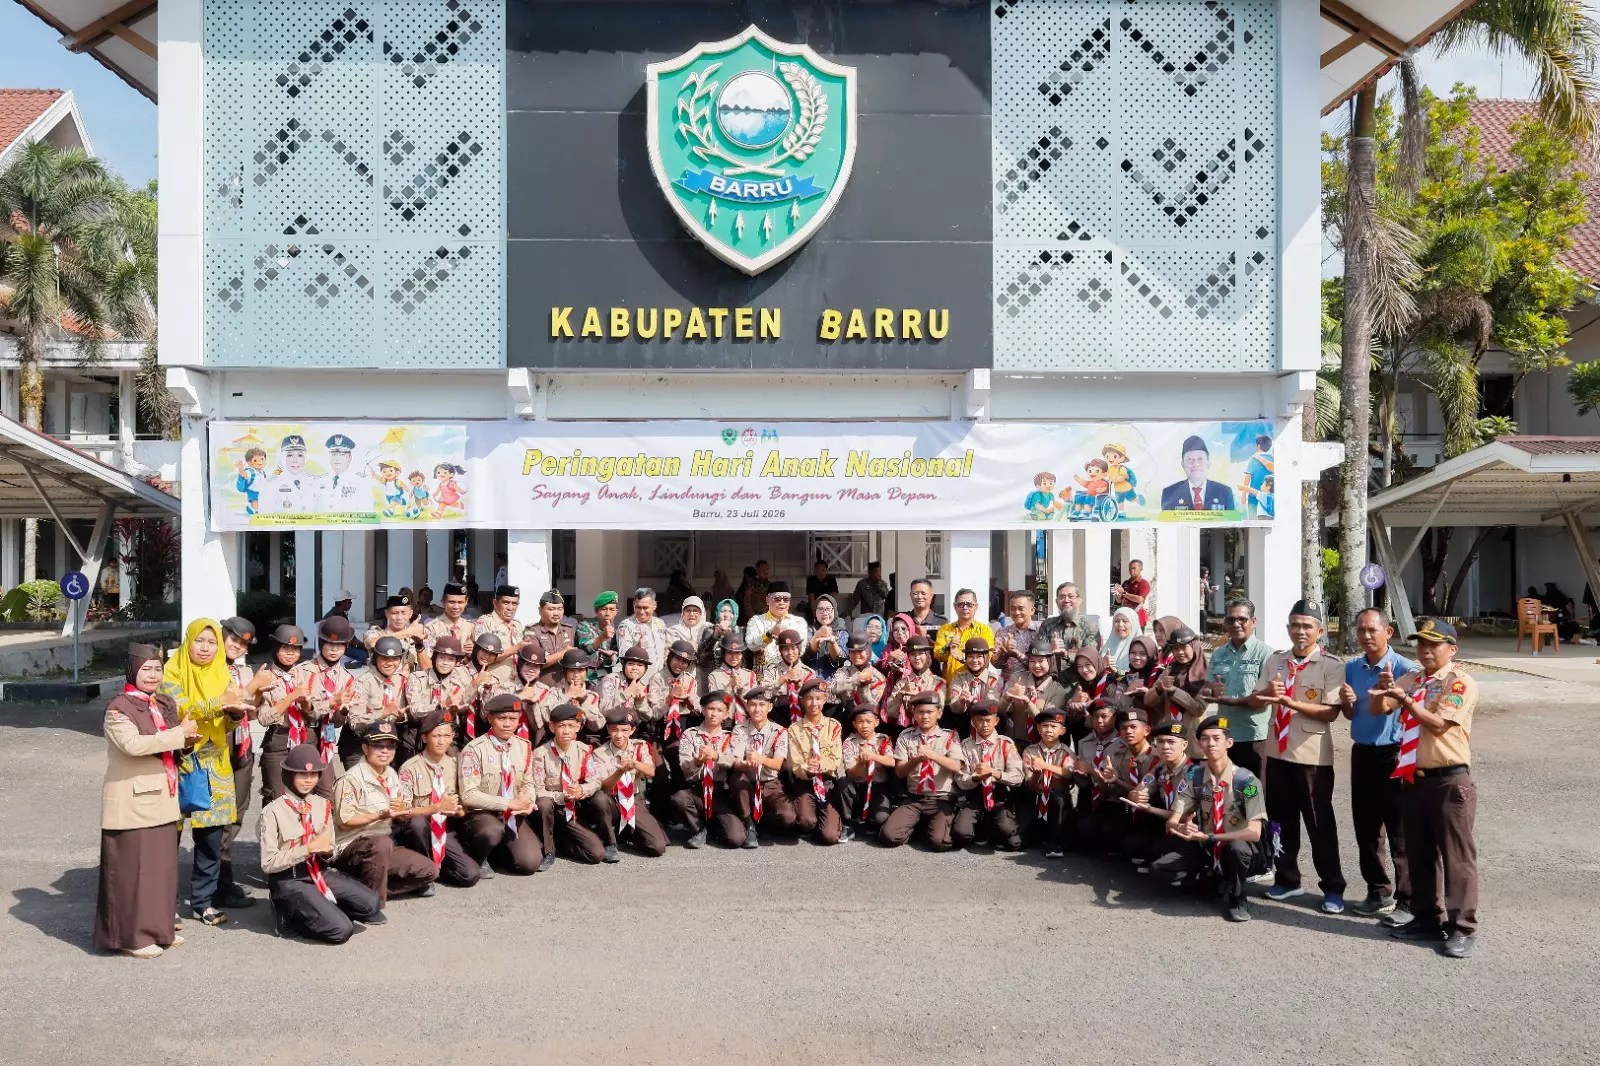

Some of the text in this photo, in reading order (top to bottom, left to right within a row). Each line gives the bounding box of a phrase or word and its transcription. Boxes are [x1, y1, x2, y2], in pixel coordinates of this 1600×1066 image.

[709, 175, 793, 199] BARRU
[551, 307, 950, 340] KABUPATEN BARRU
[522, 448, 974, 483] Peringatan Hari Anak Nasional
[532, 484, 938, 507] Sayang Anak, Lindungi dan Bangun Masa Depan
[726, 509, 738, 518] 23
[741, 509, 760, 518] Juli
[762, 509, 786, 518] 2026
